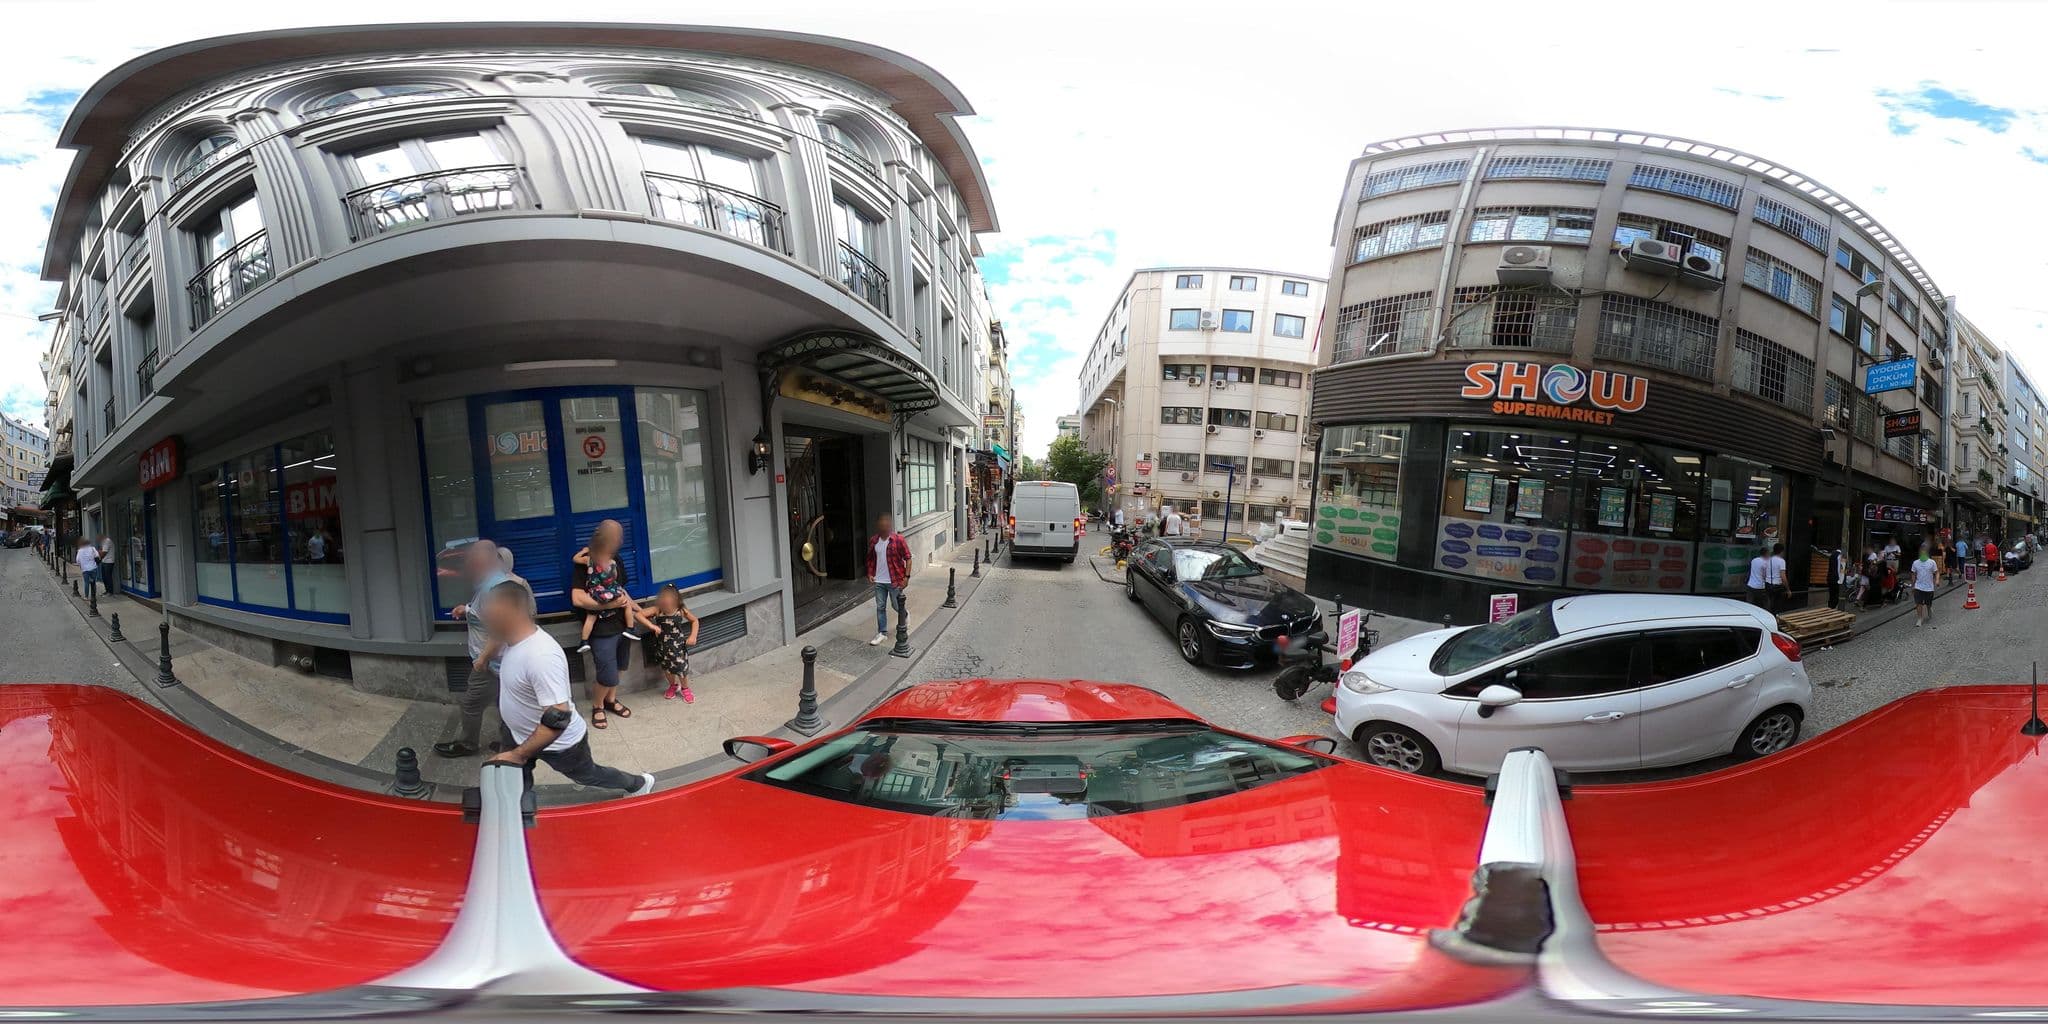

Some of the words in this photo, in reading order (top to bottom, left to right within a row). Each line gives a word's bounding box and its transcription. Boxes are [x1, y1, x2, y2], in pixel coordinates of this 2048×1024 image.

[1461, 362, 1649, 413] SHOW
[1491, 401, 1615, 426] SUPERMARKET
[1886, 415, 1919, 428] SHOW
[1339, 536, 1368, 547] SHOW
[1478, 559, 1518, 573] SHOW
